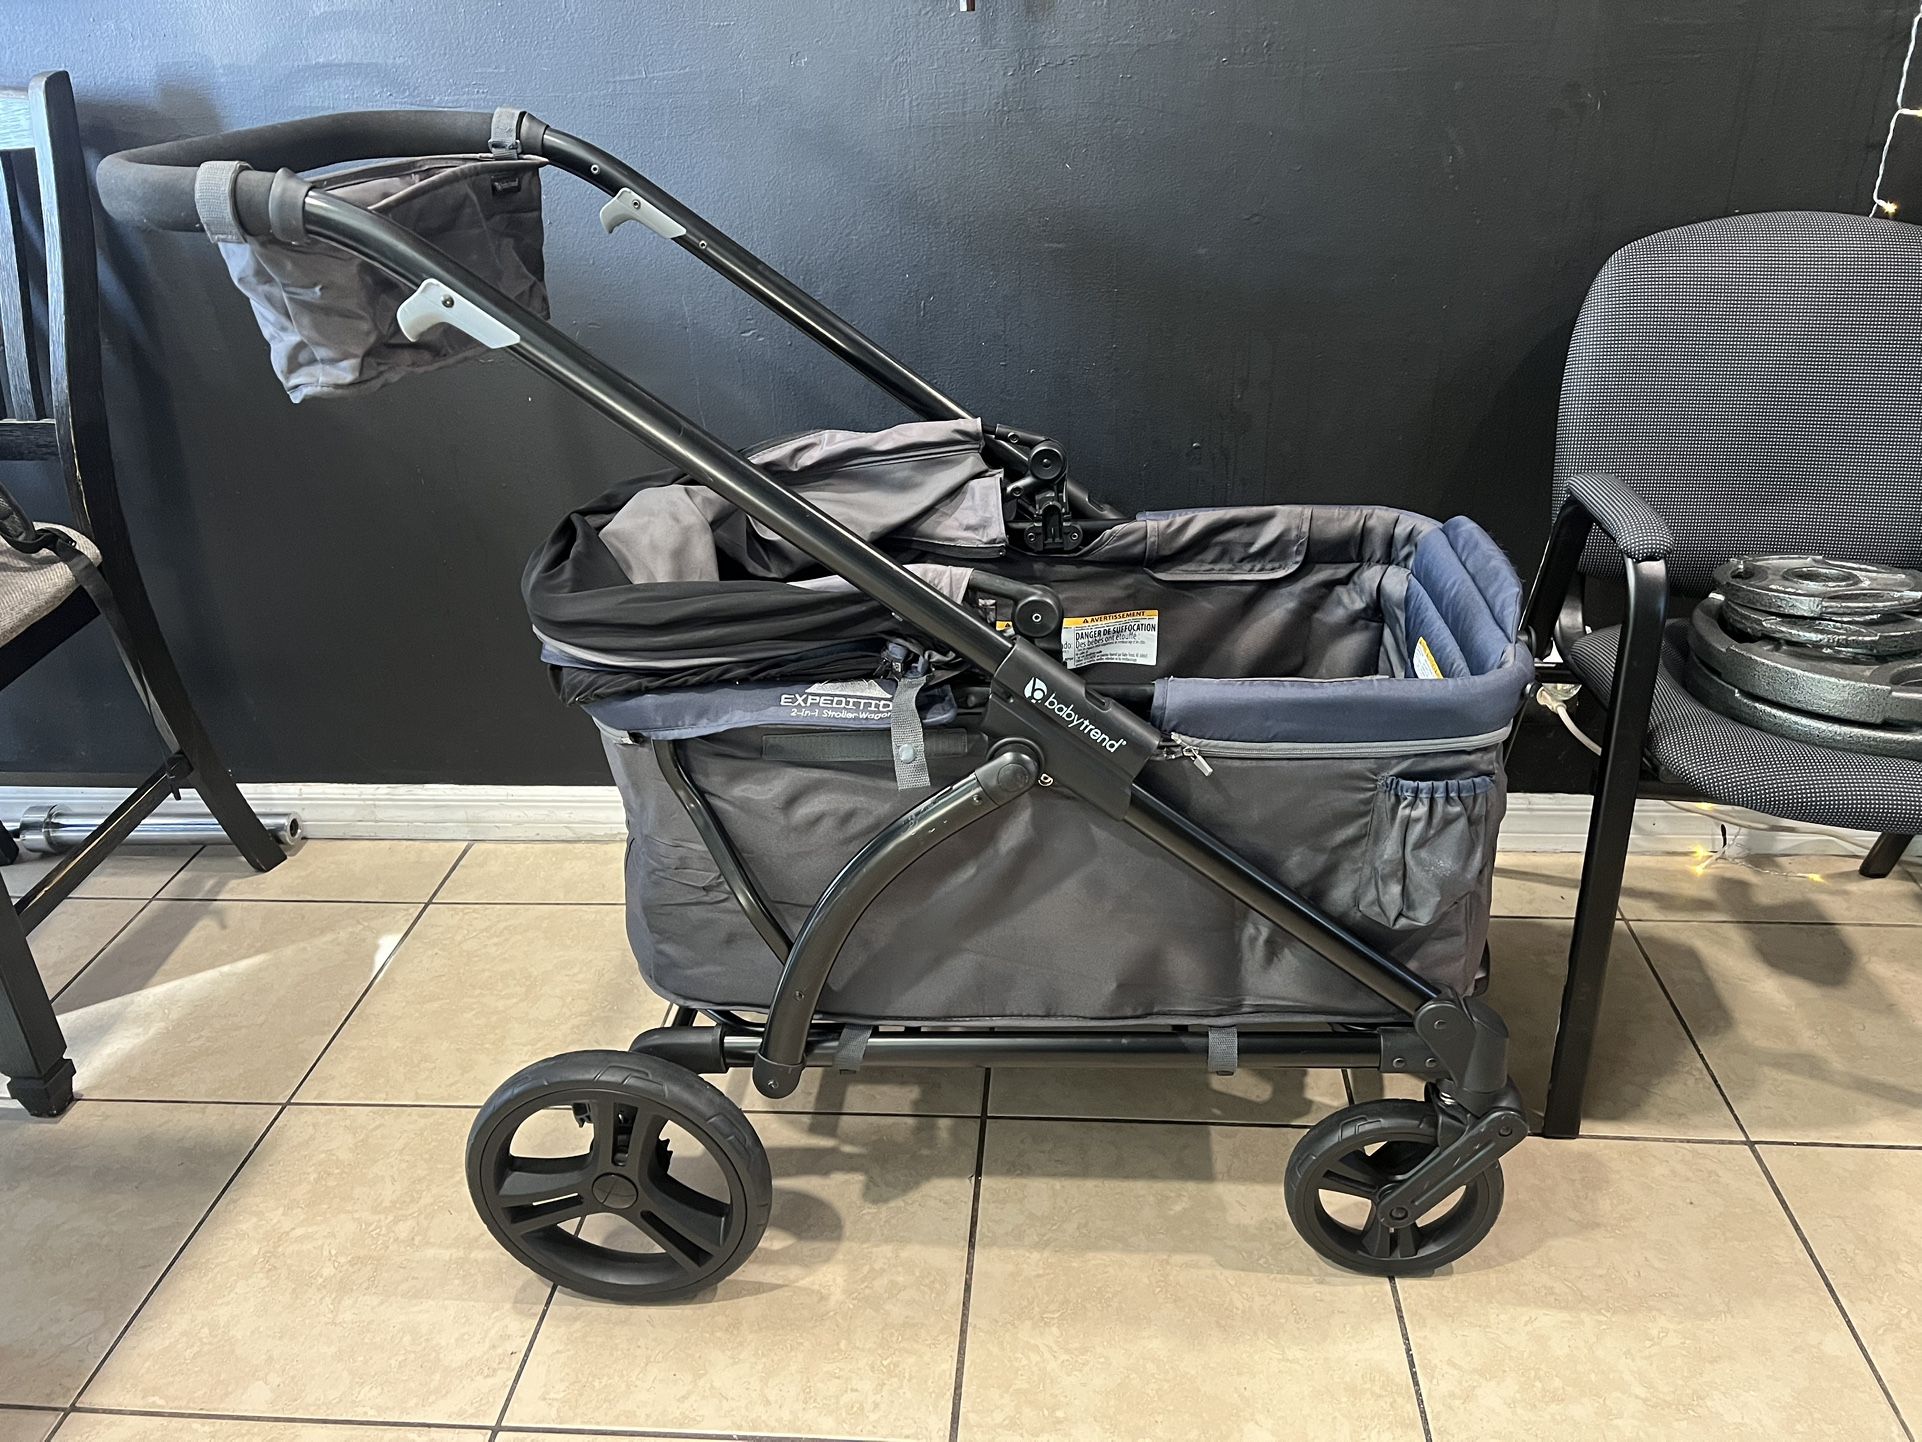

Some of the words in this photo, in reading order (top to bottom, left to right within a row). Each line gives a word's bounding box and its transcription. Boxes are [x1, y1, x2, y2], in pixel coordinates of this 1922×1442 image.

[1090, 611, 1145, 623] AVERTISSEMENT
[1075, 629, 1102, 641] DANGER
[1103, 627, 1111, 636] DE
[1112, 623, 1156, 635] SUFFOCATION
[1075, 640, 1086, 649] Des
[780, 694, 893, 711] EXPEDITIO
[822, 709, 859, 719] Stroller
[1044, 692, 1123, 753] babytrend
